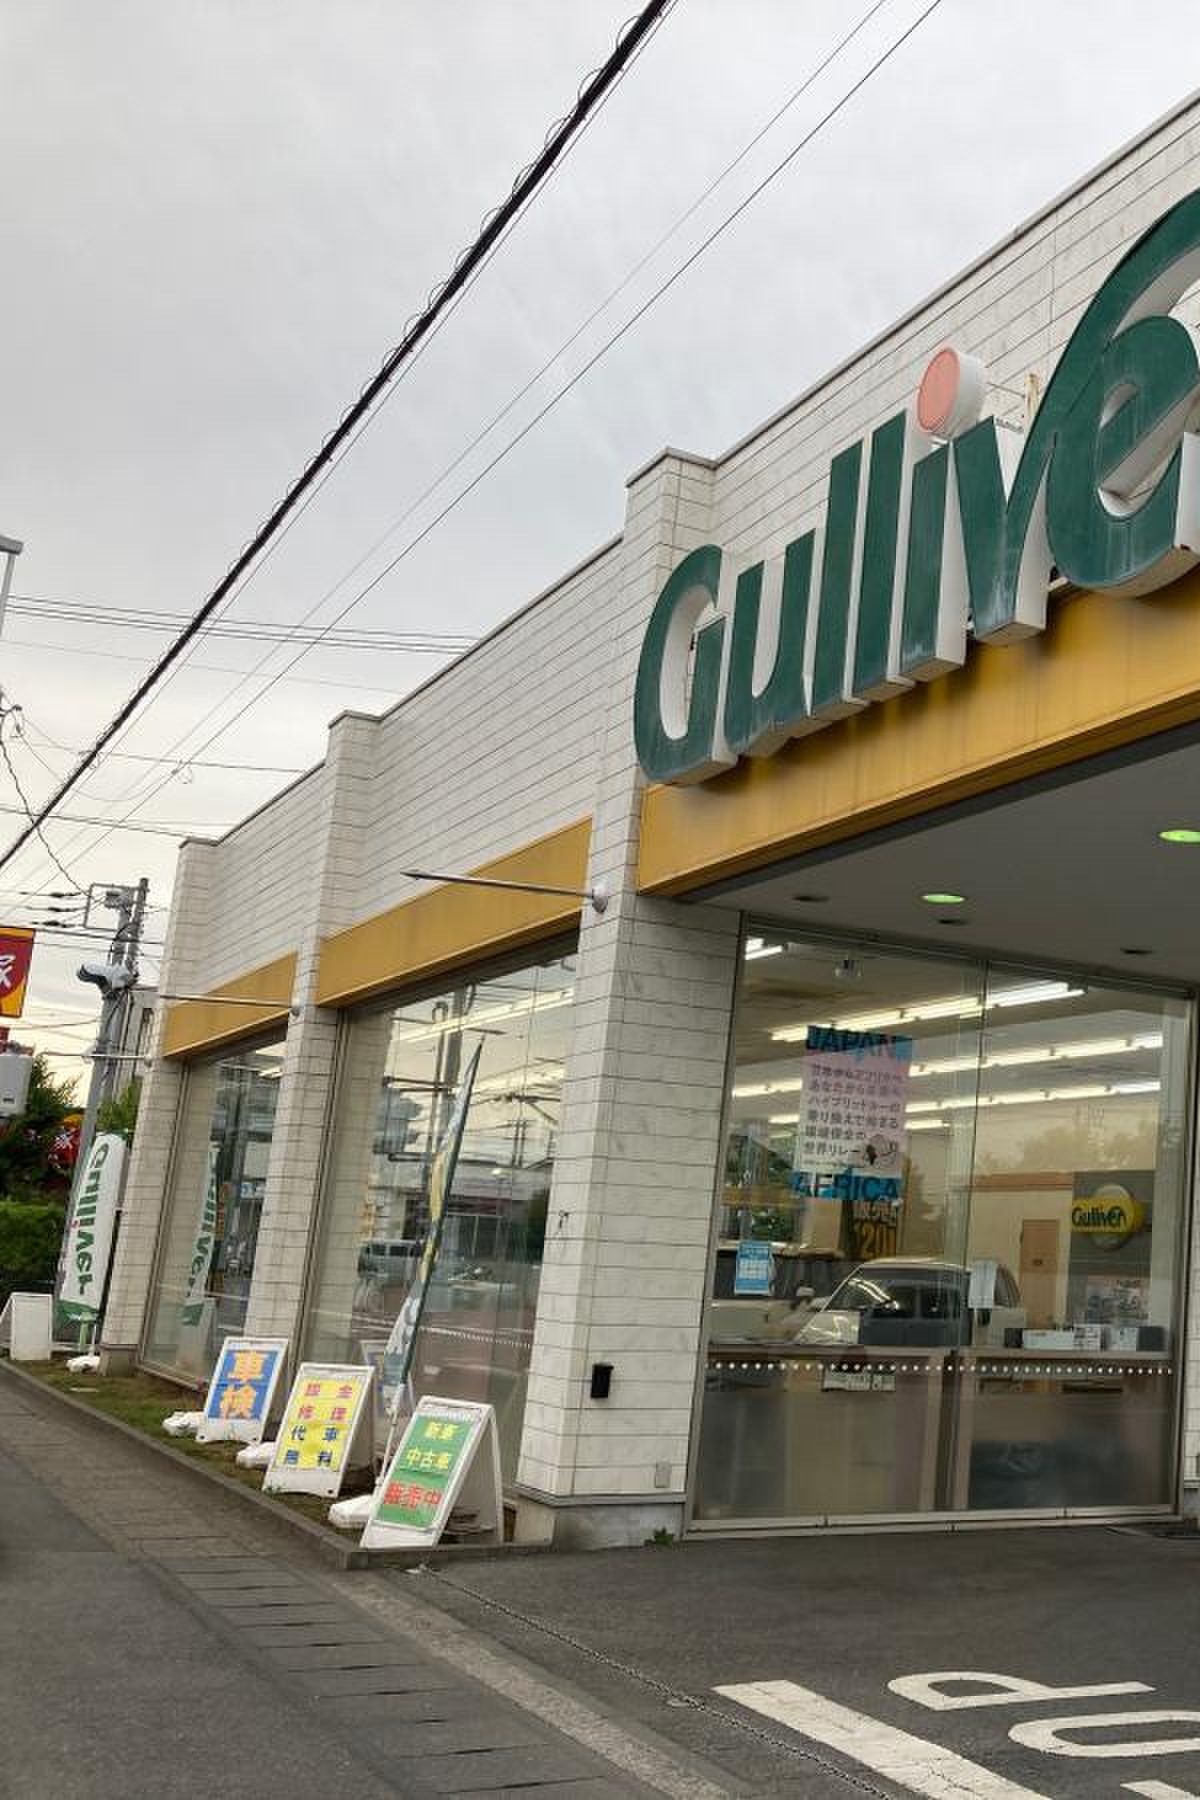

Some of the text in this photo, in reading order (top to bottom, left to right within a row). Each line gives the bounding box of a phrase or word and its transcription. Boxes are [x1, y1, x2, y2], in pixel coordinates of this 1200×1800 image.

[1072, 1204, 1126, 1228] Gulliver
[219, 1349, 268, 1420] 車検
[291, 1425, 339, 1441] 代車
[406, 1447, 450, 1468] 中古車
